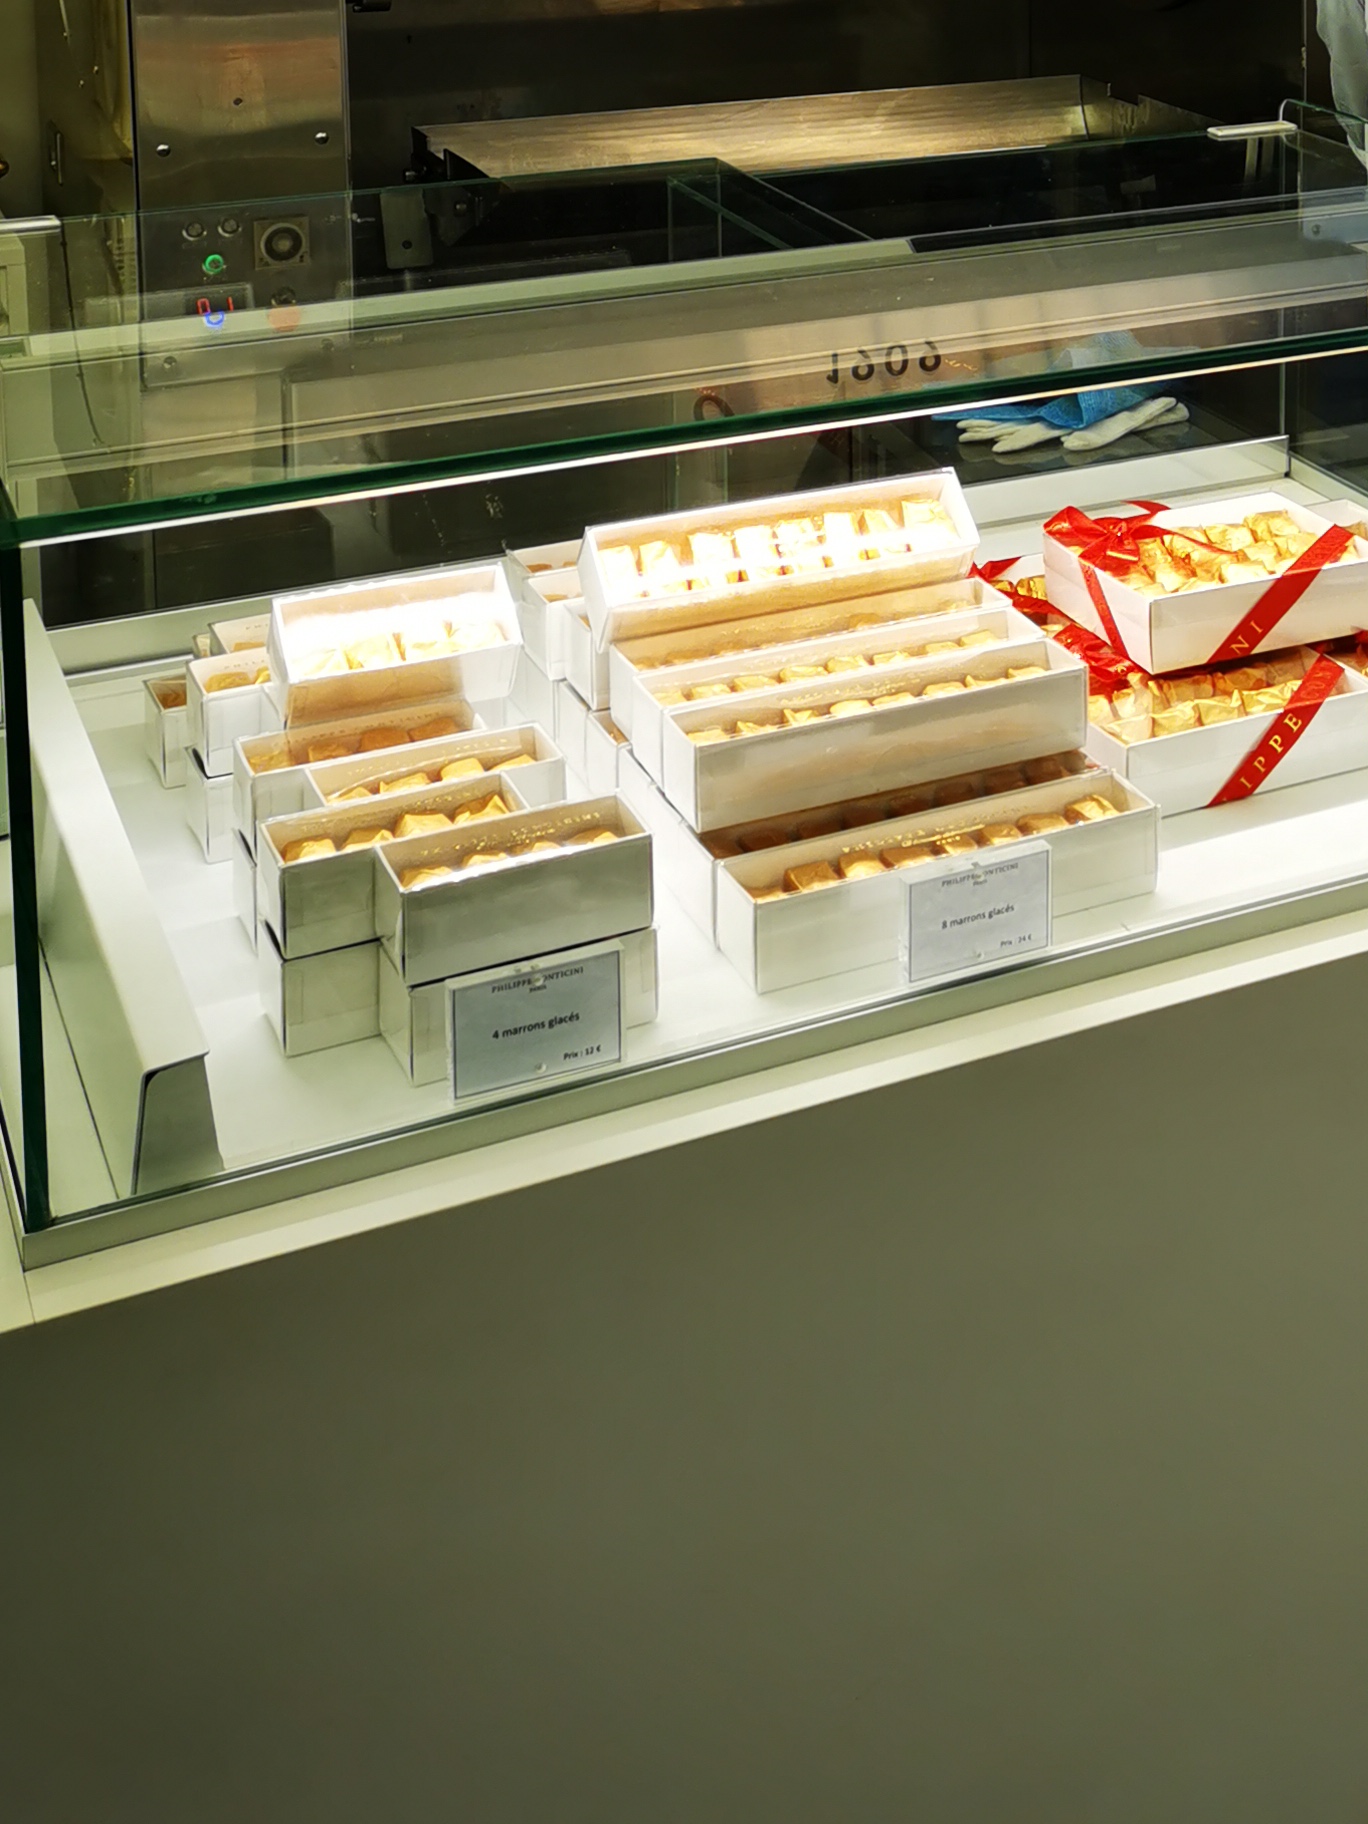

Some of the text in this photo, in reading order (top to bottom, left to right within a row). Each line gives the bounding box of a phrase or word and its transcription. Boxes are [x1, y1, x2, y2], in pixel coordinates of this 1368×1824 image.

[941, 903, 1014, 930] 8 marrons glacés
[491, 978, 532, 993] PHILIPPE
[492, 1011, 580, 1040] 4 marrons glacés
[563, 1051, 579, 1060] Prix
[584, 1046, 594, 1056] 12
[596, 1044, 601, 1053] €
